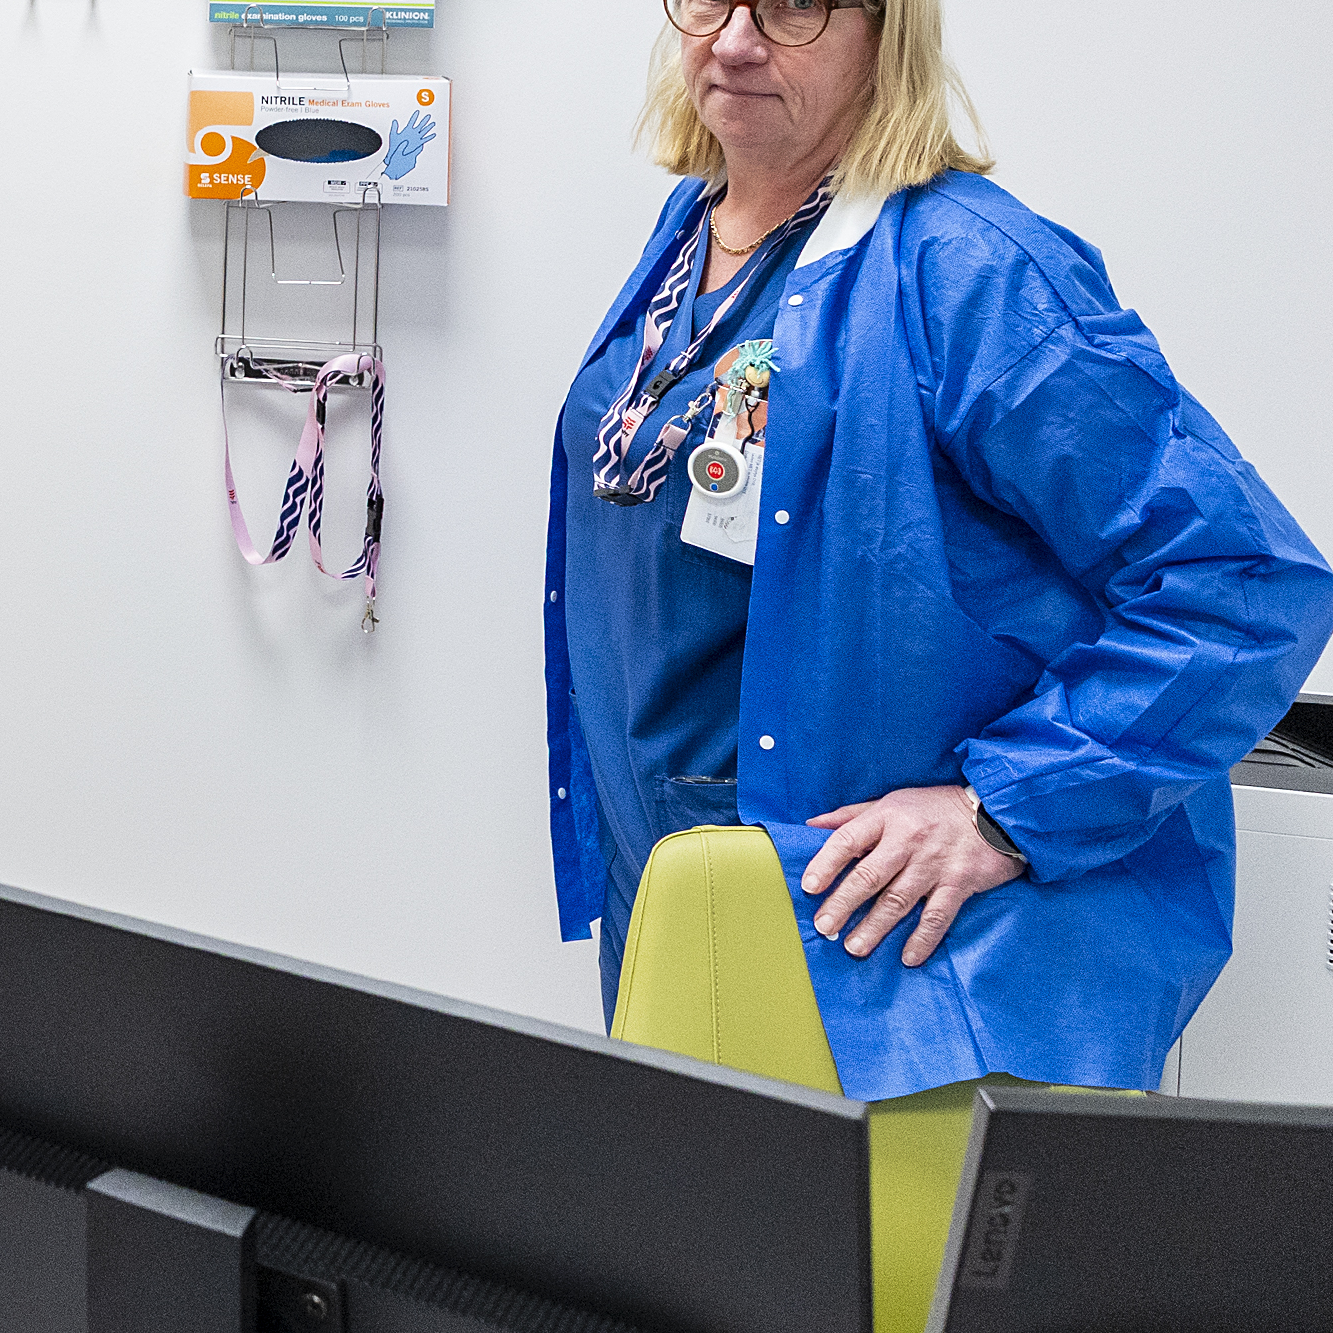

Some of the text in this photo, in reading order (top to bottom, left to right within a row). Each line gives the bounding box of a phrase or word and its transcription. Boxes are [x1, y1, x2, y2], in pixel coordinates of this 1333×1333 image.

[214, 11, 240, 20] nitrile
[241, 12, 297, 22] examination
[298, 13, 328, 23] gloves
[386, 11, 430, 20] KLINION
[261, 96, 390, 108] NITRILE Medical Exam Gloves
[421, 92, 429, 102] S
[260, 105, 299, 113] Powder-free
[213, 173, 253, 185] SENSE
[971, 1178, 1017, 1279] Lenovo
